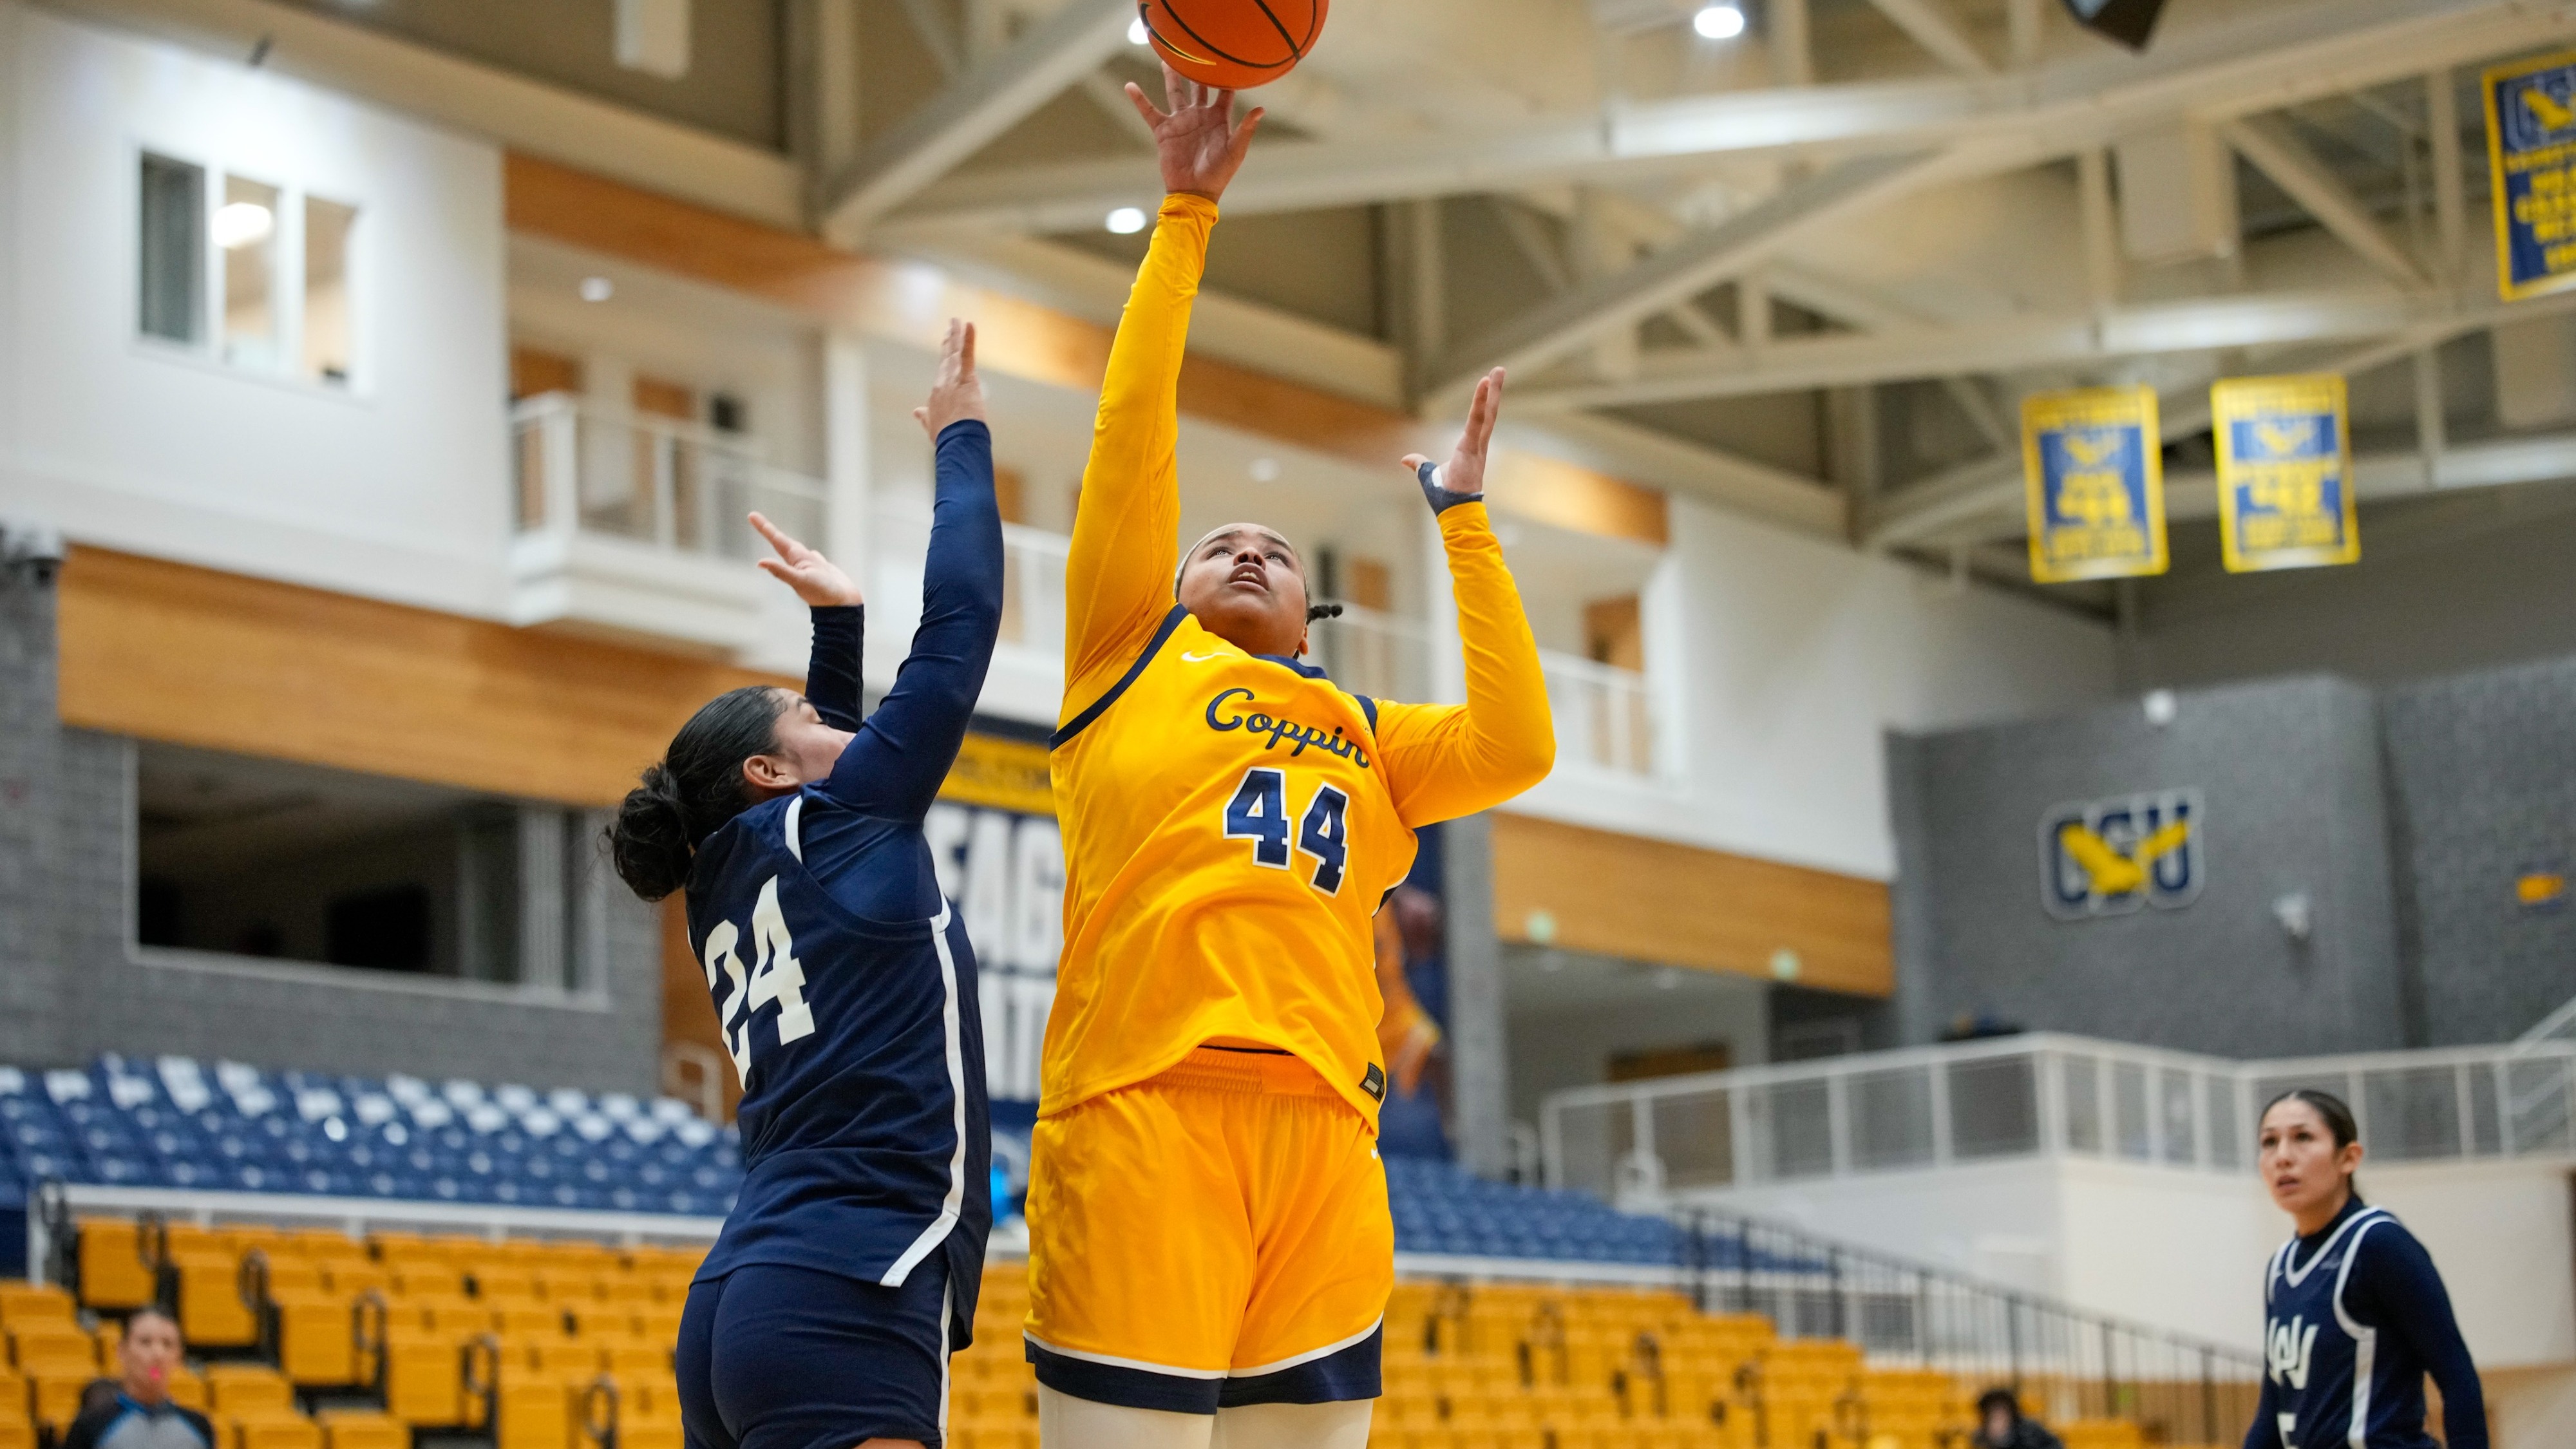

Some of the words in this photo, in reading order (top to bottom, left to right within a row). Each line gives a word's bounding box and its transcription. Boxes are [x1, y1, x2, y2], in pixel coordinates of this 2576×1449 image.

[1206, 687, 1370, 769] Coppin
[1222, 766, 1350, 899] 44
[704, 873, 816, 1093] 24
